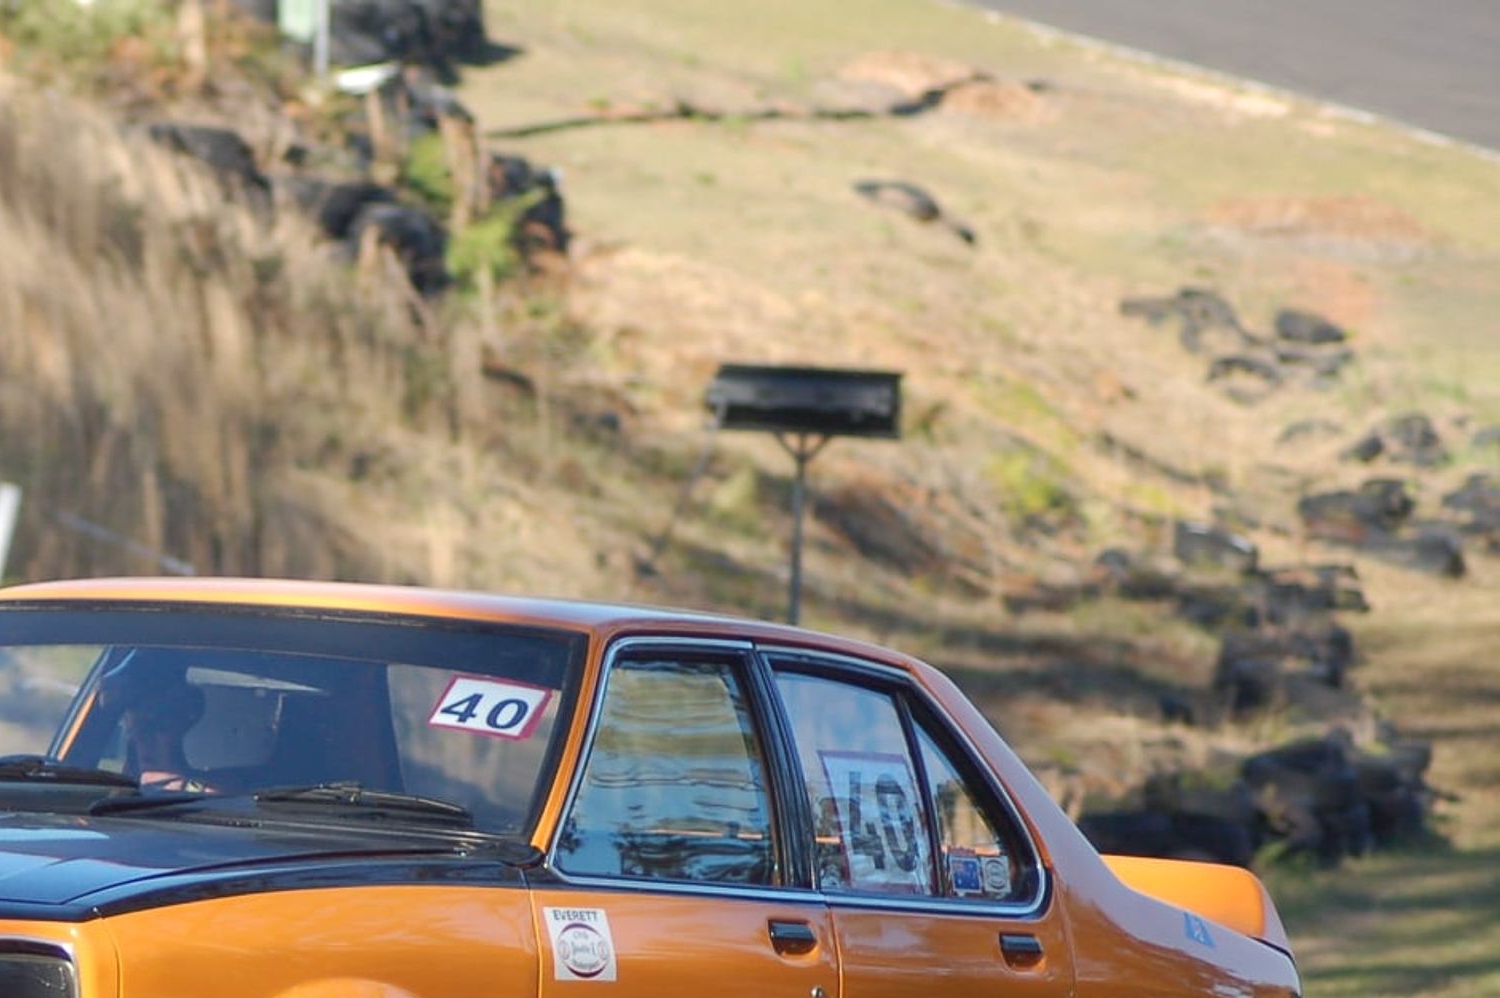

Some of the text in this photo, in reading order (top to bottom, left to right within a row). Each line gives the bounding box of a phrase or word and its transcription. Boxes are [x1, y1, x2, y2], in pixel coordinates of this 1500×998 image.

[440, 693, 529, 730] 40
[848, 771, 918, 872] 40
[553, 910, 597, 920] EVERETT
